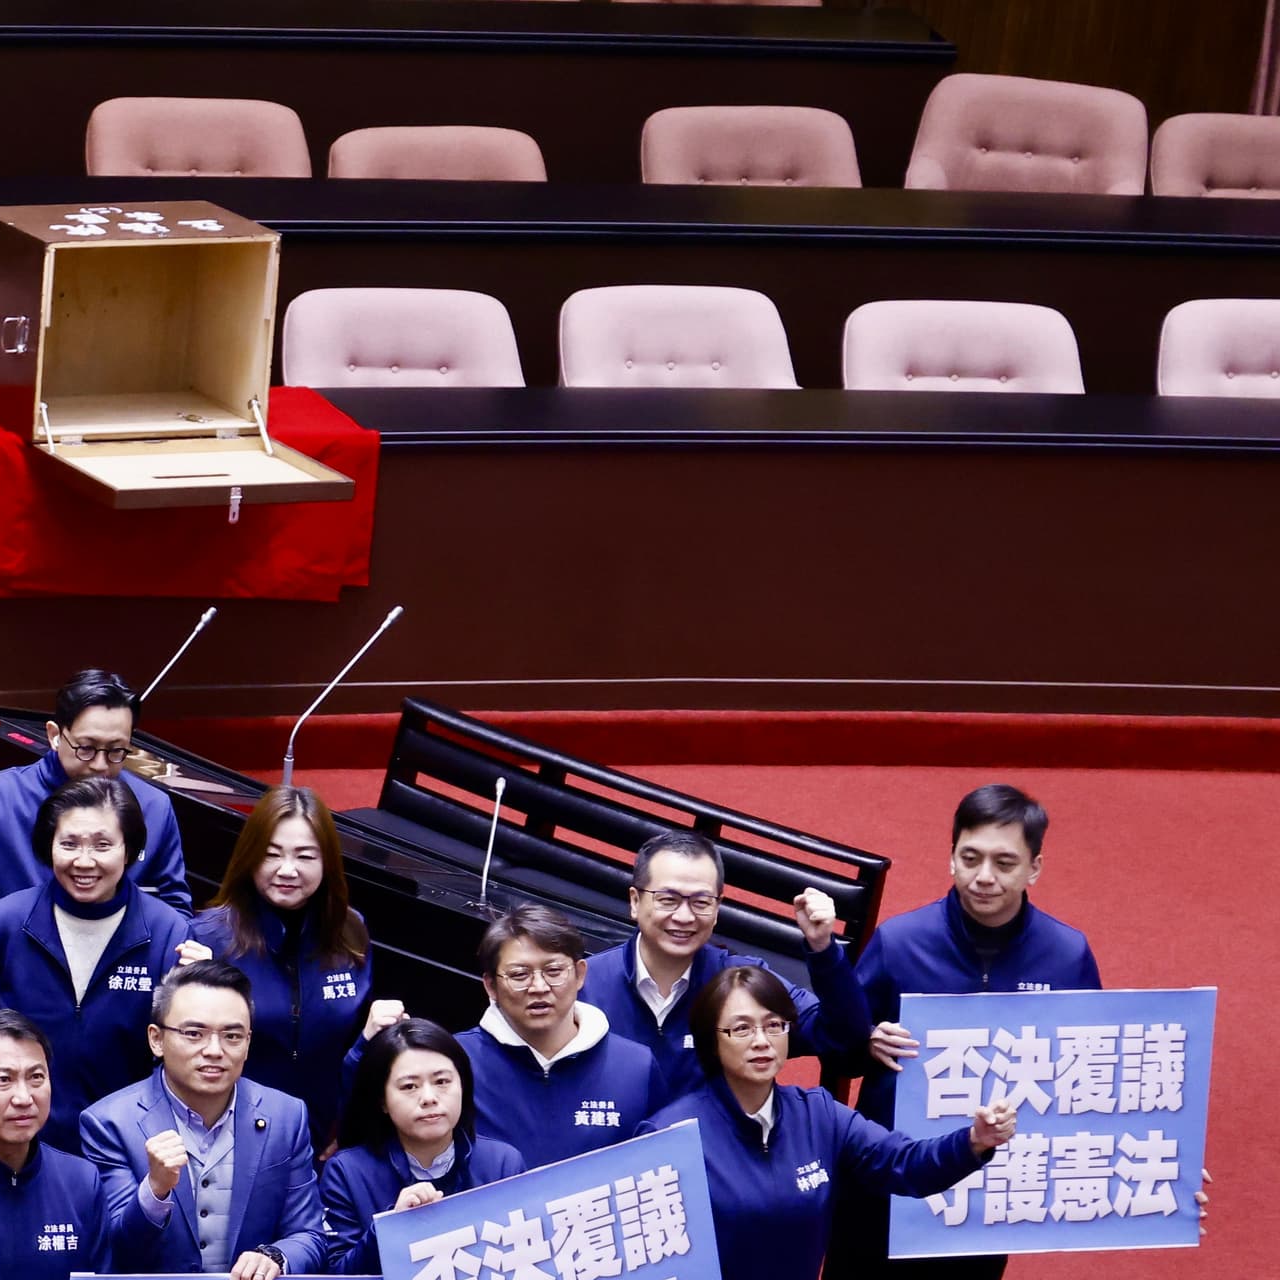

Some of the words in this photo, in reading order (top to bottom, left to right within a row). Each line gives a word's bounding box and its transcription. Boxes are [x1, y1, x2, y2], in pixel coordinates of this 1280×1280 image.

[117, 966, 147, 975] 立法委員
[108, 975, 152, 991] 徐欣瑩
[323, 982, 356, 999] 馬文君
[923, 1023, 1187, 1119] 否決覆議
[581, 1101, 615, 1110] 立法委員
[574, 1110, 621, 1127] 黃建賓
[43, 1224, 73, 1233] 立法委員
